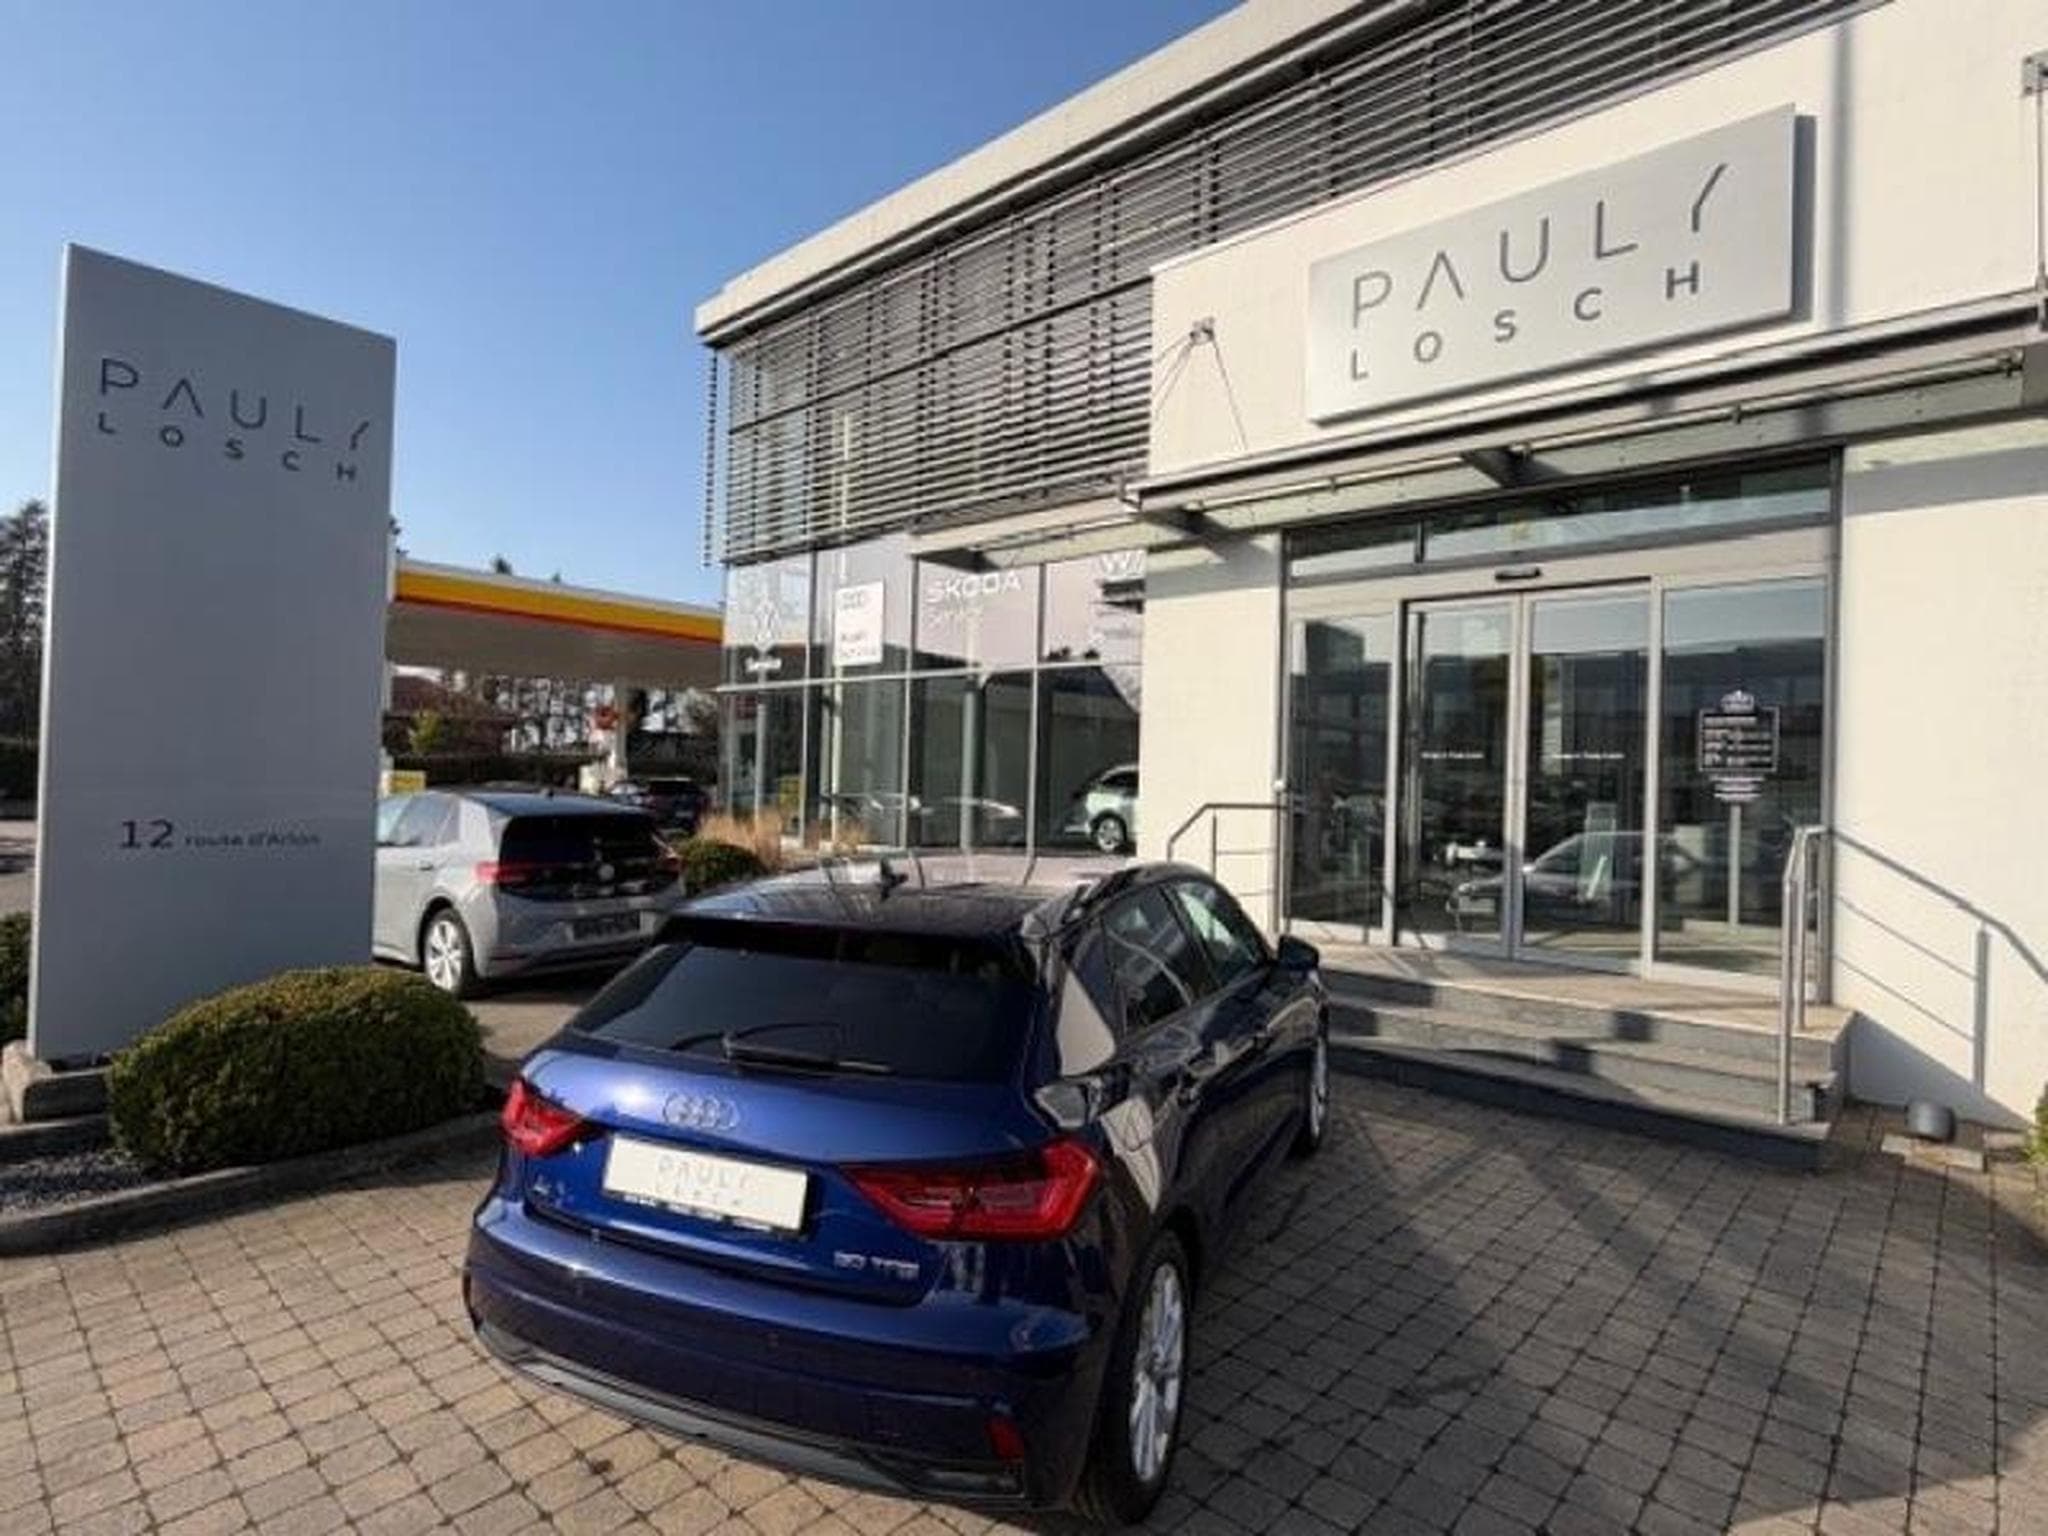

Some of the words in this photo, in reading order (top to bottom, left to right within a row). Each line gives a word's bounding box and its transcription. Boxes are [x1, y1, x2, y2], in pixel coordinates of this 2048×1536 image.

[1352, 163, 1727, 328] PAULY
[1351, 261, 1701, 381] LOSCH
[98, 412, 356, 481] LOSCH
[101, 357, 370, 450] PAULY
[119, 819, 174, 848] 12
